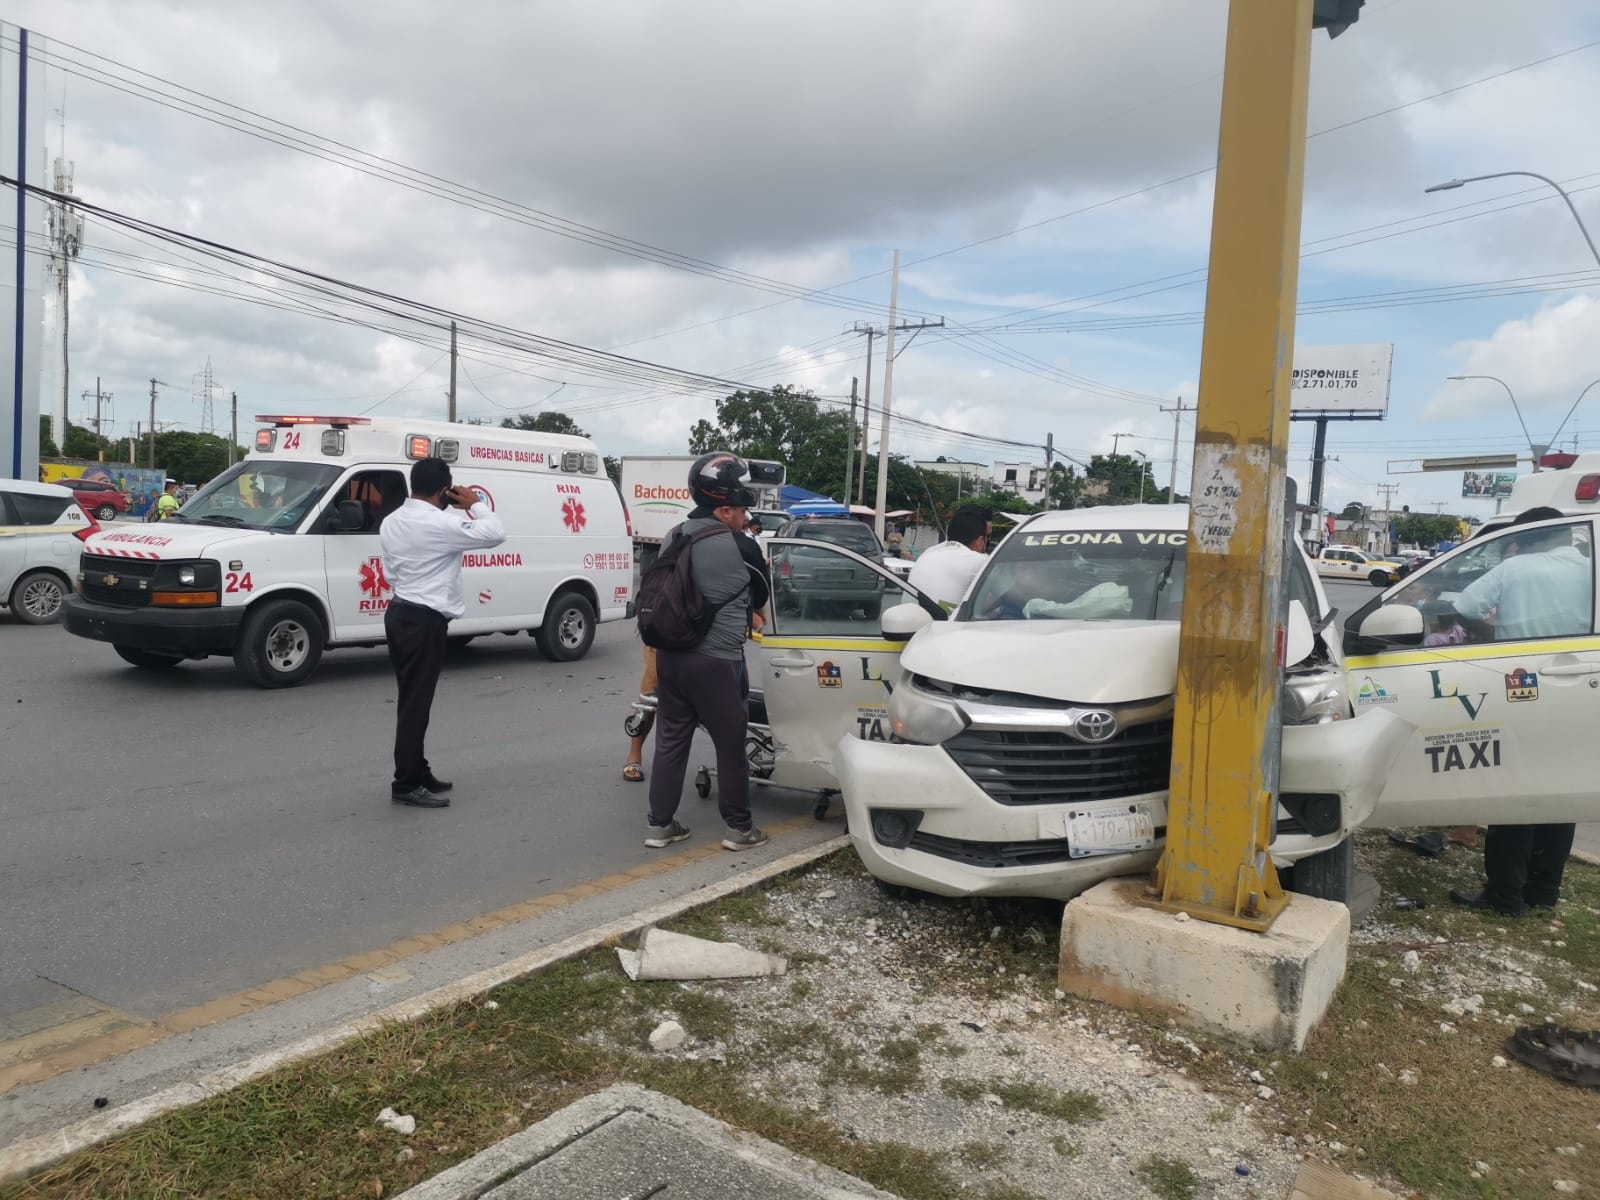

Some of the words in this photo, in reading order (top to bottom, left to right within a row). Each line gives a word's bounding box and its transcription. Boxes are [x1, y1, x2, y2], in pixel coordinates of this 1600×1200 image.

[1292, 369, 1359, 379] DISPONIBLE
[284, 432, 300, 449] 24
[470, 446, 513, 461] URGENCIAS
[515, 451, 544, 464] BASICAS
[556, 484, 581, 494] RIM
[634, 484, 692, 500] Bachoco
[1024, 533, 1123, 546] LEONA
[1136, 533, 1188, 545] VIC
[461, 554, 523, 568] MBULANCIA
[225, 573, 253, 593] 24
[360, 600, 391, 610] RIM
[857, 717, 898, 742] TA
[1424, 740, 1501, 773] TAXI
